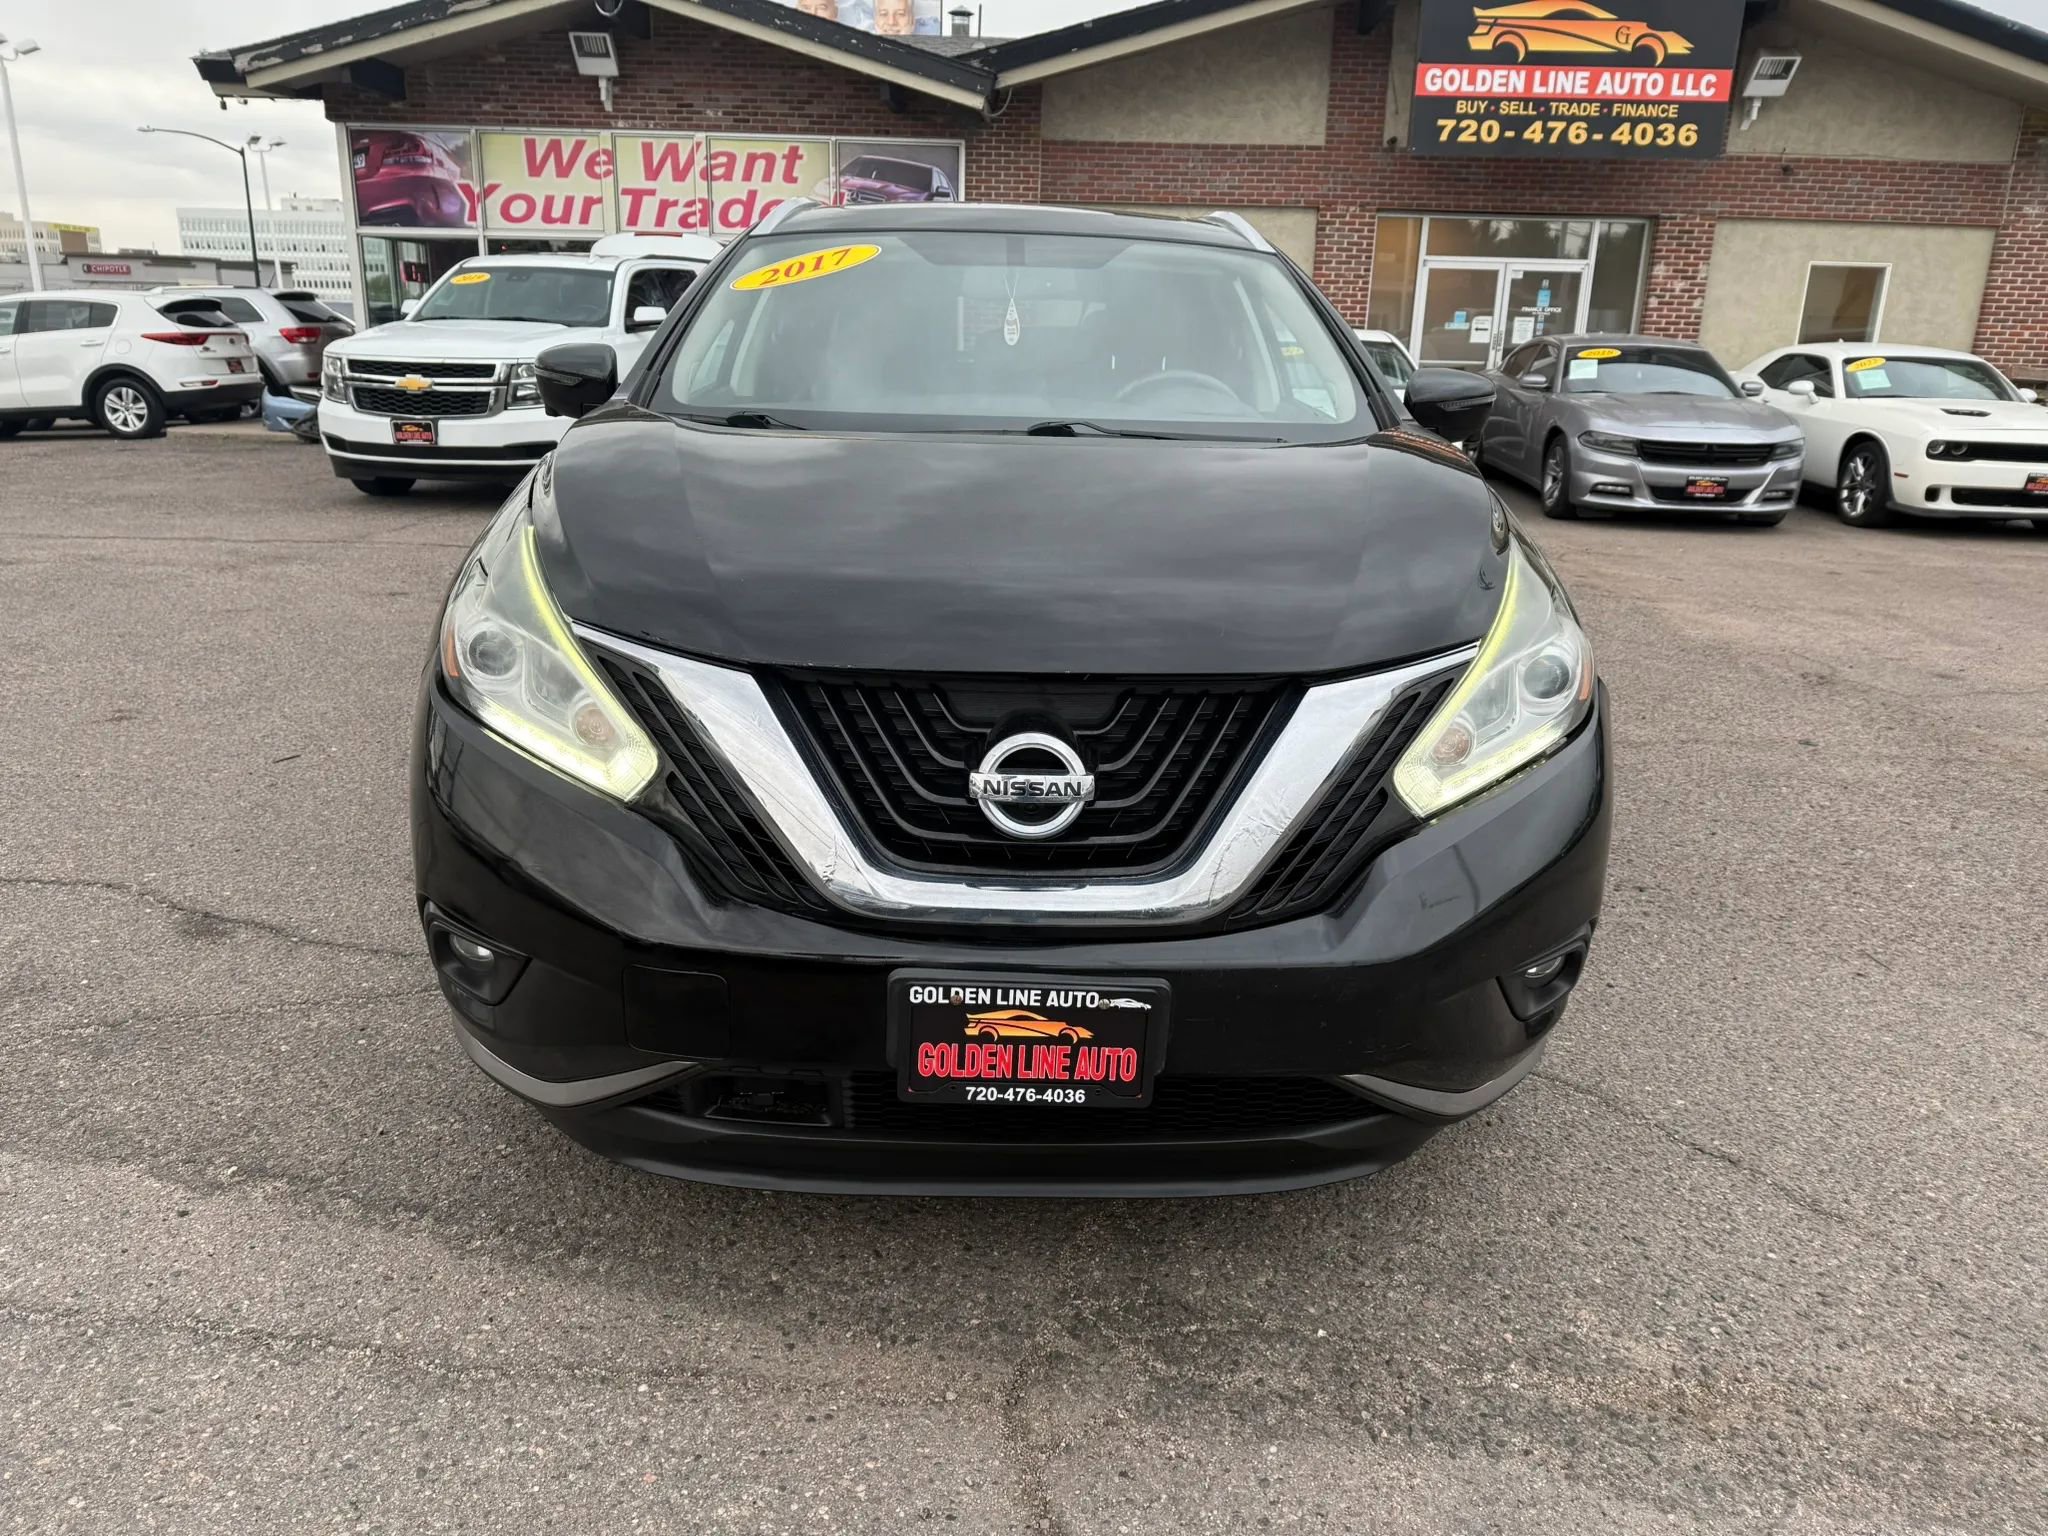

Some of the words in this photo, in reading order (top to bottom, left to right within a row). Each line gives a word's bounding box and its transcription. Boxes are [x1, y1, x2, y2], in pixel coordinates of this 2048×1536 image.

[1425, 68, 1526, 94] GOLDEN
[1532, 70, 1590, 94] LINE
[1595, 72, 1664, 96] AUTO
[1671, 73, 1717, 97] LLC
[1456, 100, 1488, 114] BUY
[1499, 101, 1537, 115] SELL
[1550, 102, 1600, 116] TRADE
[1612, 104, 1679, 118] FINANCE
[523, 138, 613, 179] We
[641, 141, 804, 184] Want
[456, 182, 603, 225] Your
[91, 265, 127, 273] CHIPOTLE
[760, 248, 852, 286] 2017
[983, 780, 1081, 796] NISSAN
[997, 988, 1041, 1007] LINE
[1046, 990, 1099, 1008] AUTO
[917, 1042, 1013, 1078] GOLDEN
[1017, 1045, 1070, 1080] LINE
[1074, 1046, 1138, 1082] AUTO
[966, 1086, 1086, 1103] 720-476-4036
